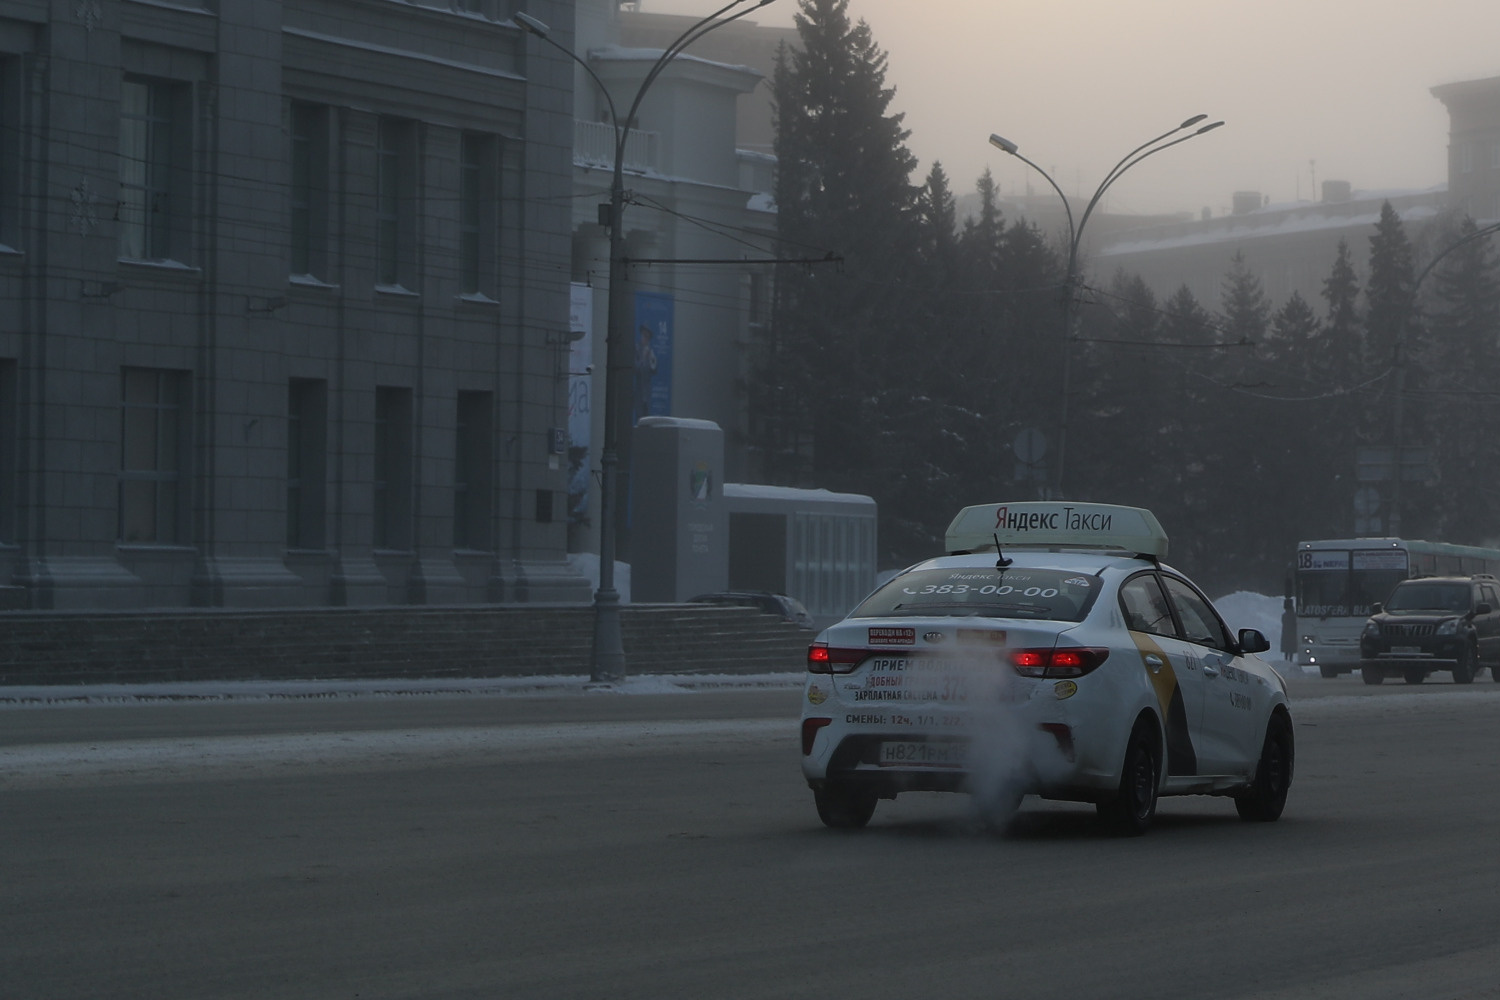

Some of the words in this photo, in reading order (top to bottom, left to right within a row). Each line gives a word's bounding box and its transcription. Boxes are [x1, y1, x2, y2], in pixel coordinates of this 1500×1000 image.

[995, 507, 1059, 531] Яндекс
[1063, 507, 1112, 531] Такси
[1298, 553, 1313, 569] 18
[949, 572, 995, 581] Яндекс
[920, 584, 1059, 598] 383-00-00
[872, 659, 913, 671] ПРИЕМ
[855, 690, 902, 702] ЗАРПЛАТНАЯ
[845, 714, 887, 725] СМЕНЫ:
[891, 715, 913, 727] 12ч,
